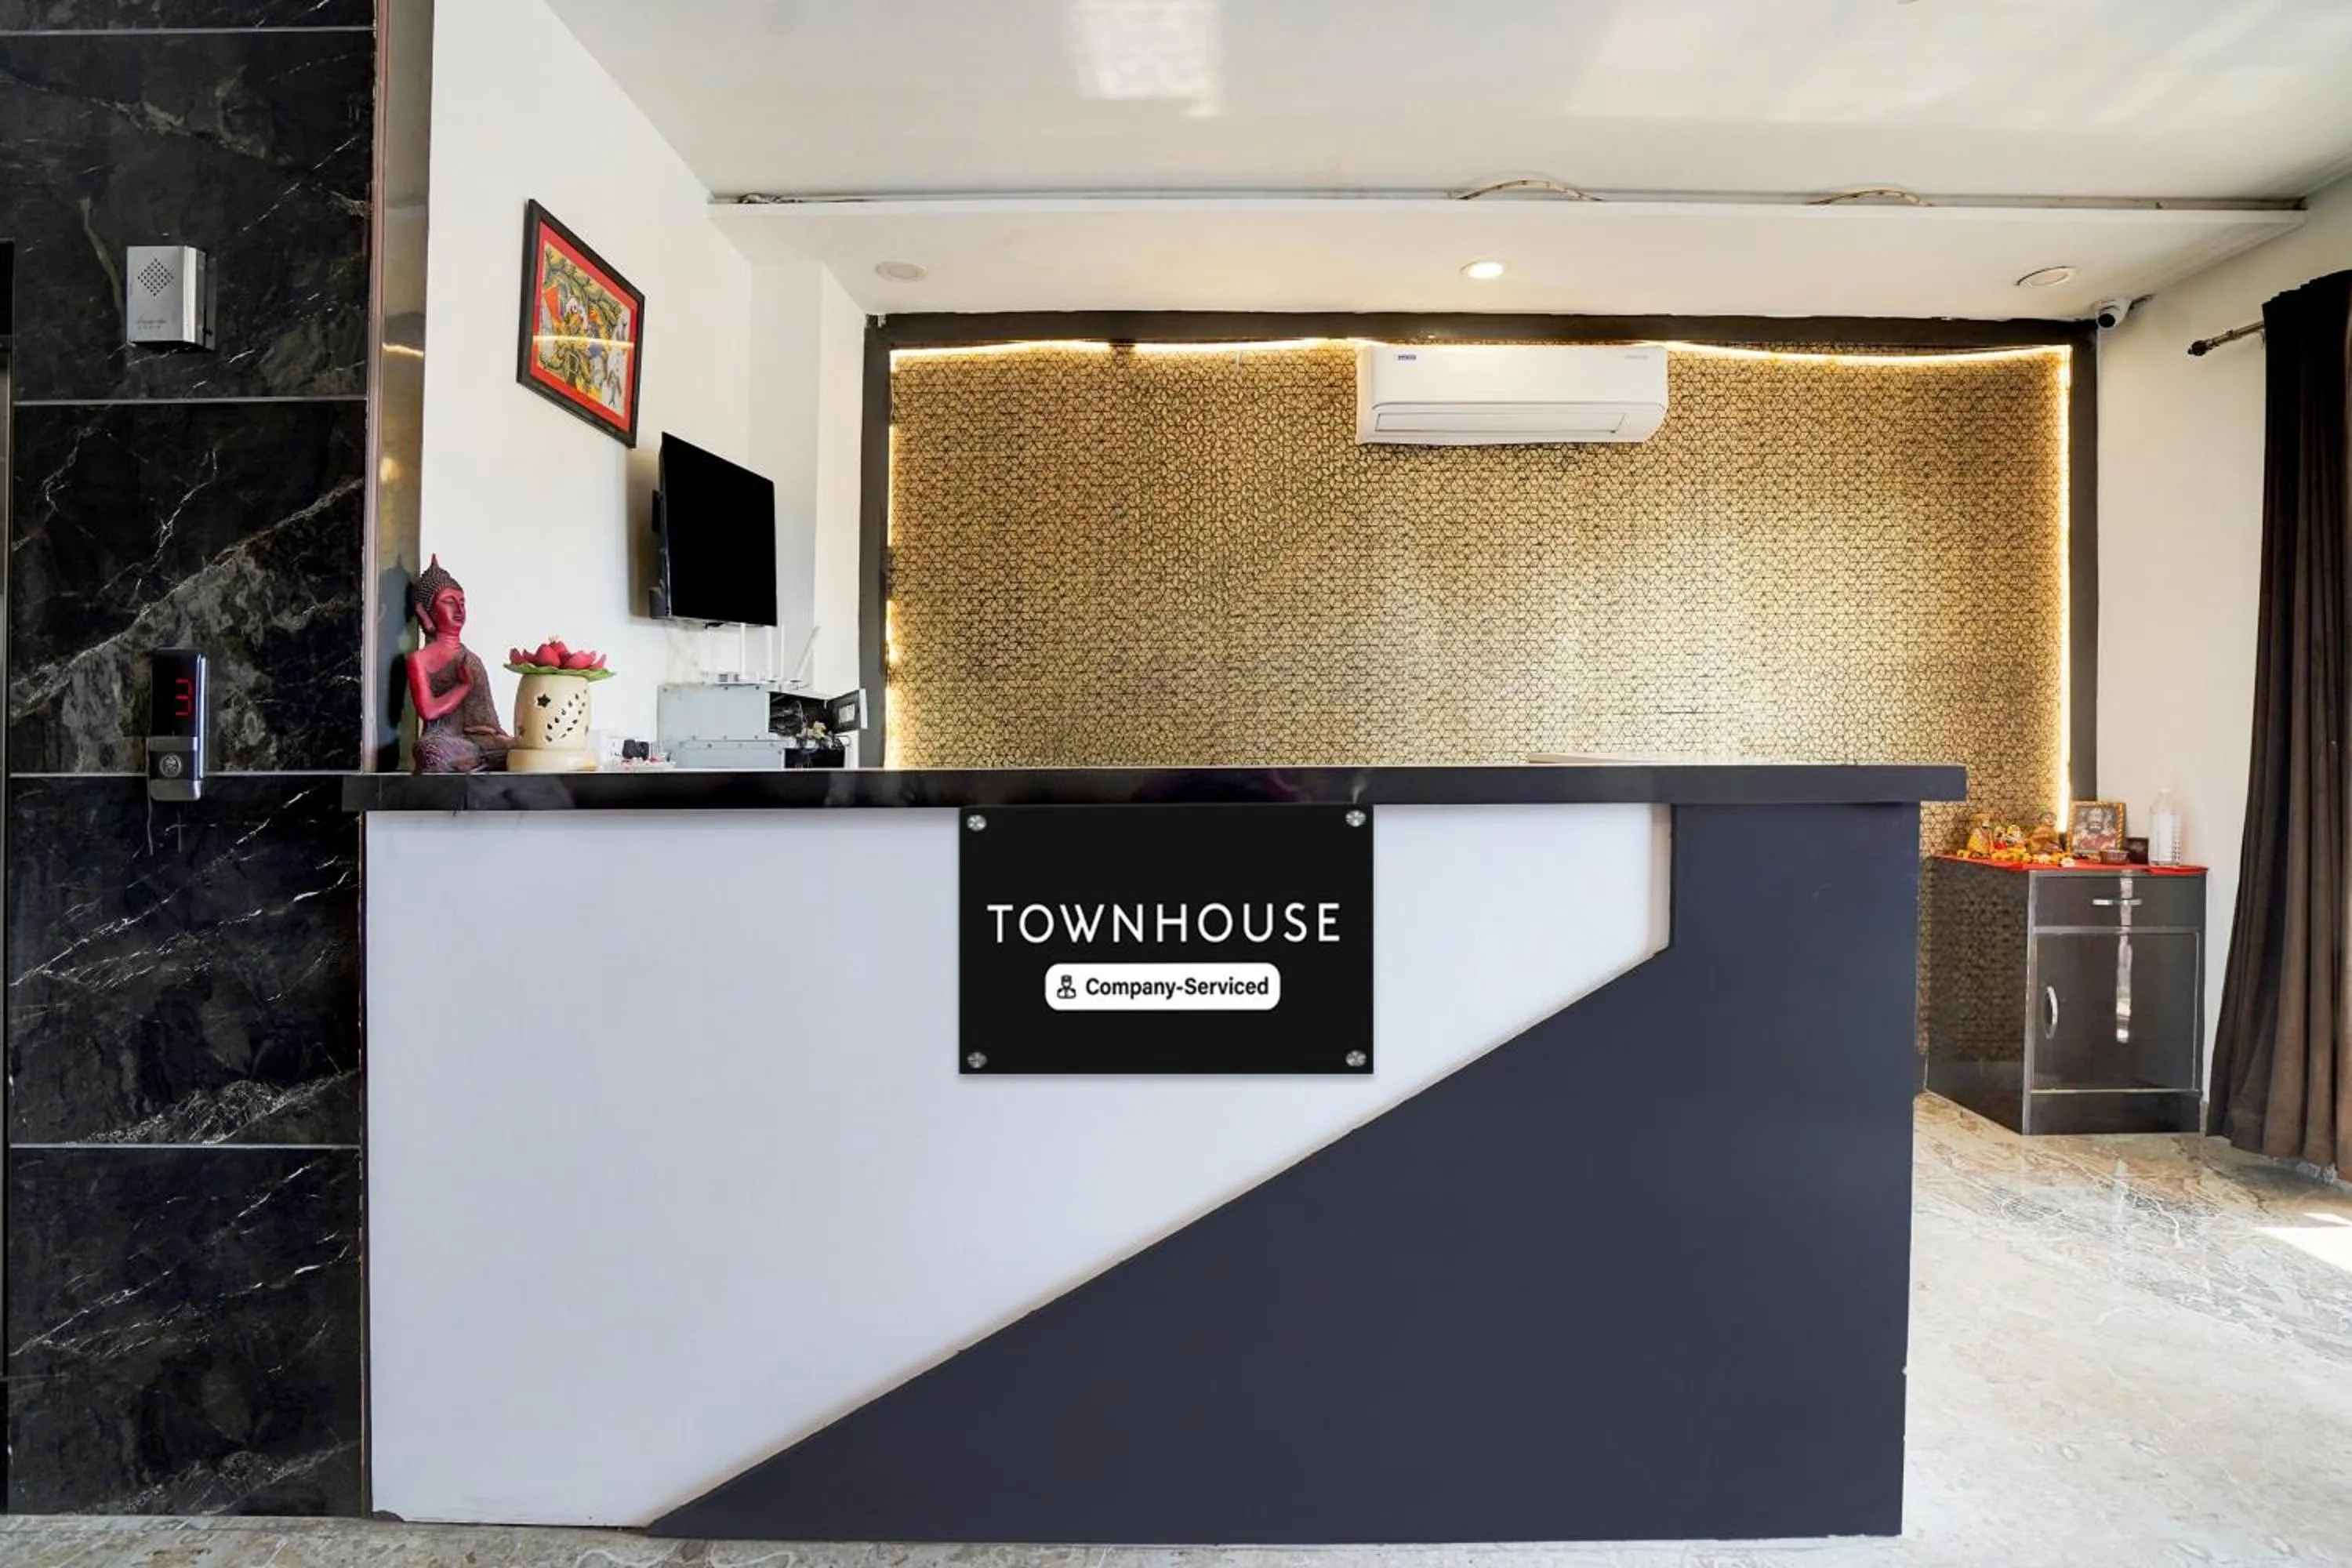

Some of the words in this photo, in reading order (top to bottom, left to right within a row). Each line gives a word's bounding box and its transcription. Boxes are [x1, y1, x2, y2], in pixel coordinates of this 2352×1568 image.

[175, 678, 192, 716] 3
[986, 902, 1340, 943] TOWNHOUSE
[1085, 976, 1269, 1000] Company-Serviced
